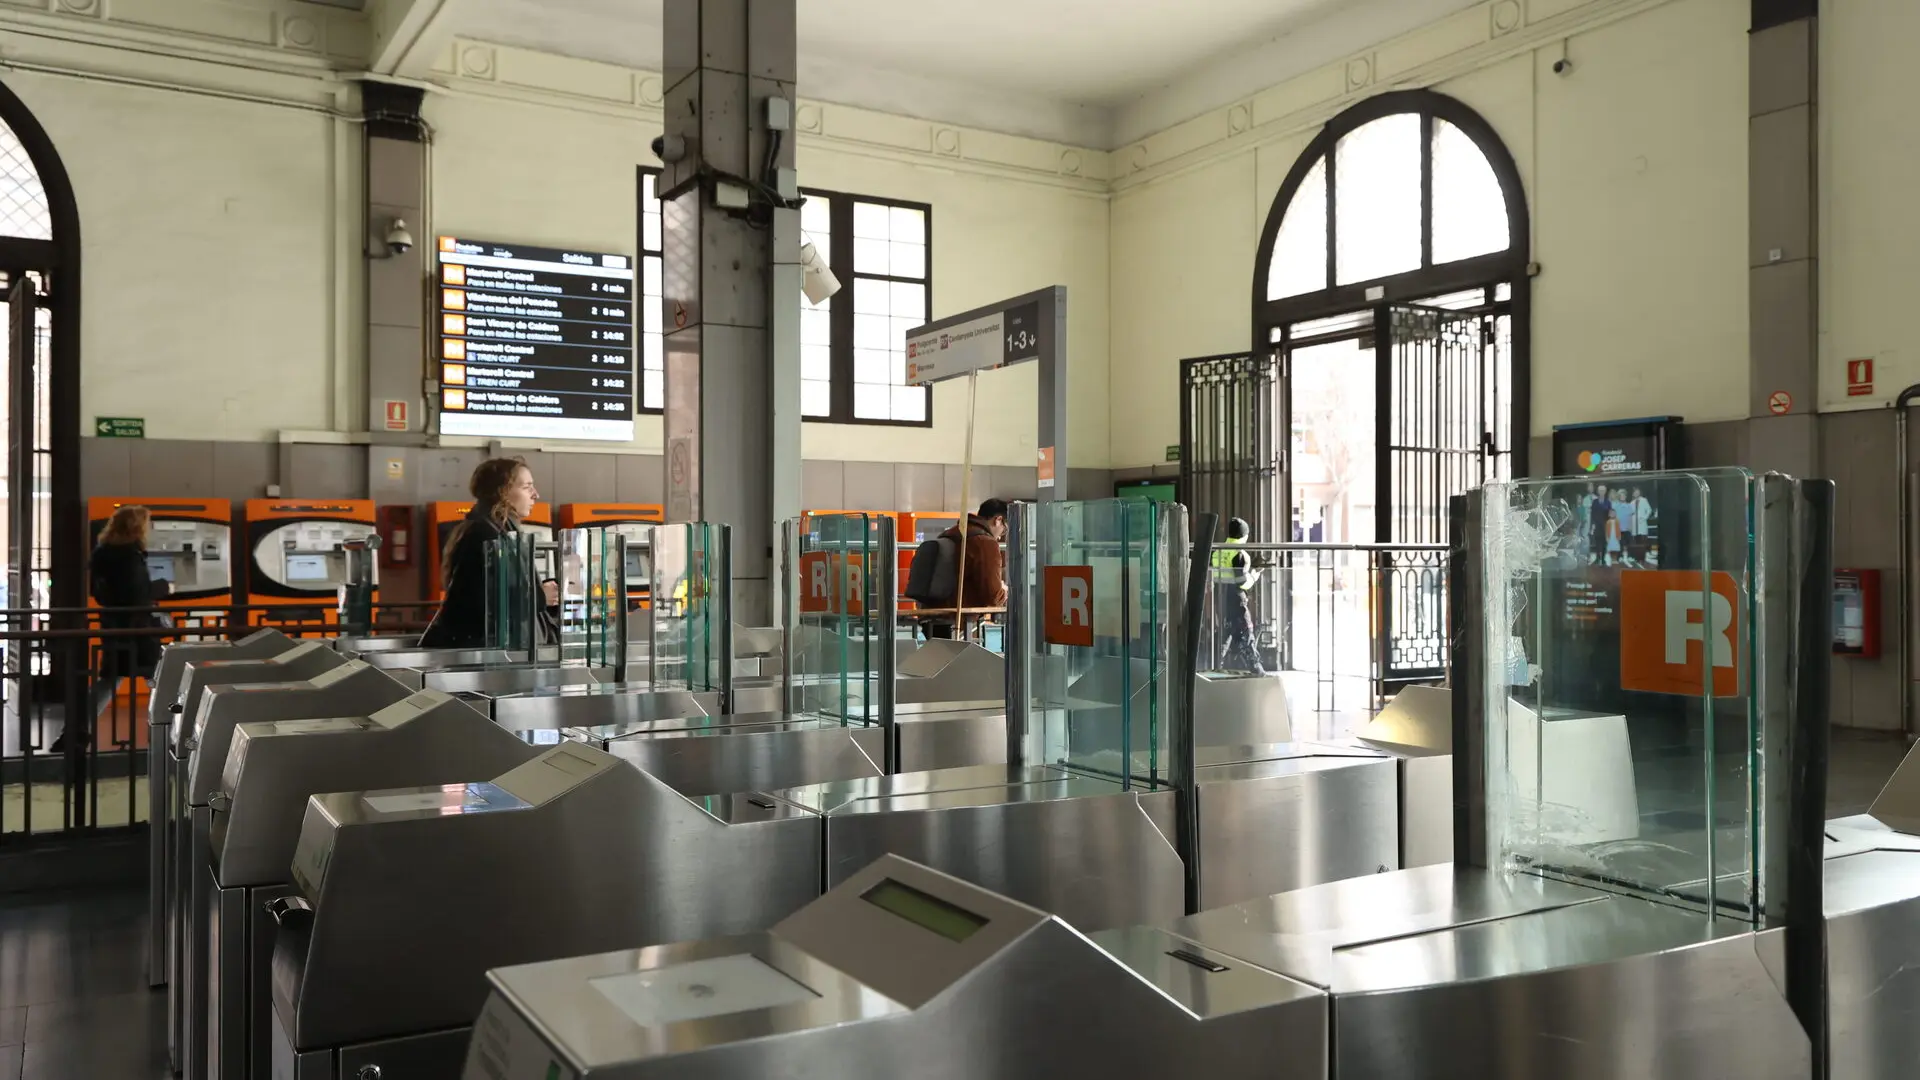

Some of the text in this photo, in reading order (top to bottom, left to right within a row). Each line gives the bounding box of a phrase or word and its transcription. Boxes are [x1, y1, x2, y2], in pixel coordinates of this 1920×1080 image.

[562, 253, 593, 265] Salidas
[466, 268, 503, 278] Martorell
[504, 272, 534, 282] Central
[591, 283, 625, 293] 2 4 min
[508, 296, 522, 304] del
[591, 307, 598, 315] 2
[609, 308, 625, 317] min
[466, 318, 486, 326] Sant
[516, 321, 527, 329] de
[528, 322, 559, 332] Calders
[591, 330, 598, 338] 2
[1008, 330, 1027, 352] 1-3
[466, 342, 503, 352] Martorell
[504, 344, 534, 354] Central
[477, 354, 498, 362] TREN
[591, 354, 598, 362] 2
[466, 367, 503, 376] Martorell
[504, 369, 534, 378] Central
[477, 378, 498, 386] TREN
[591, 378, 598, 386] 2
[466, 392, 486, 400] Sant
[516, 394, 527, 402] de
[528, 395, 560, 404] Calders
[591, 402, 598, 410] 2
[1601, 462, 1642, 471] CARRERAS
[812, 560, 826, 600] R
[846, 564, 862, 600] R
[1062, 576, 1088, 626] R
[1665, 590, 1734, 668] R
